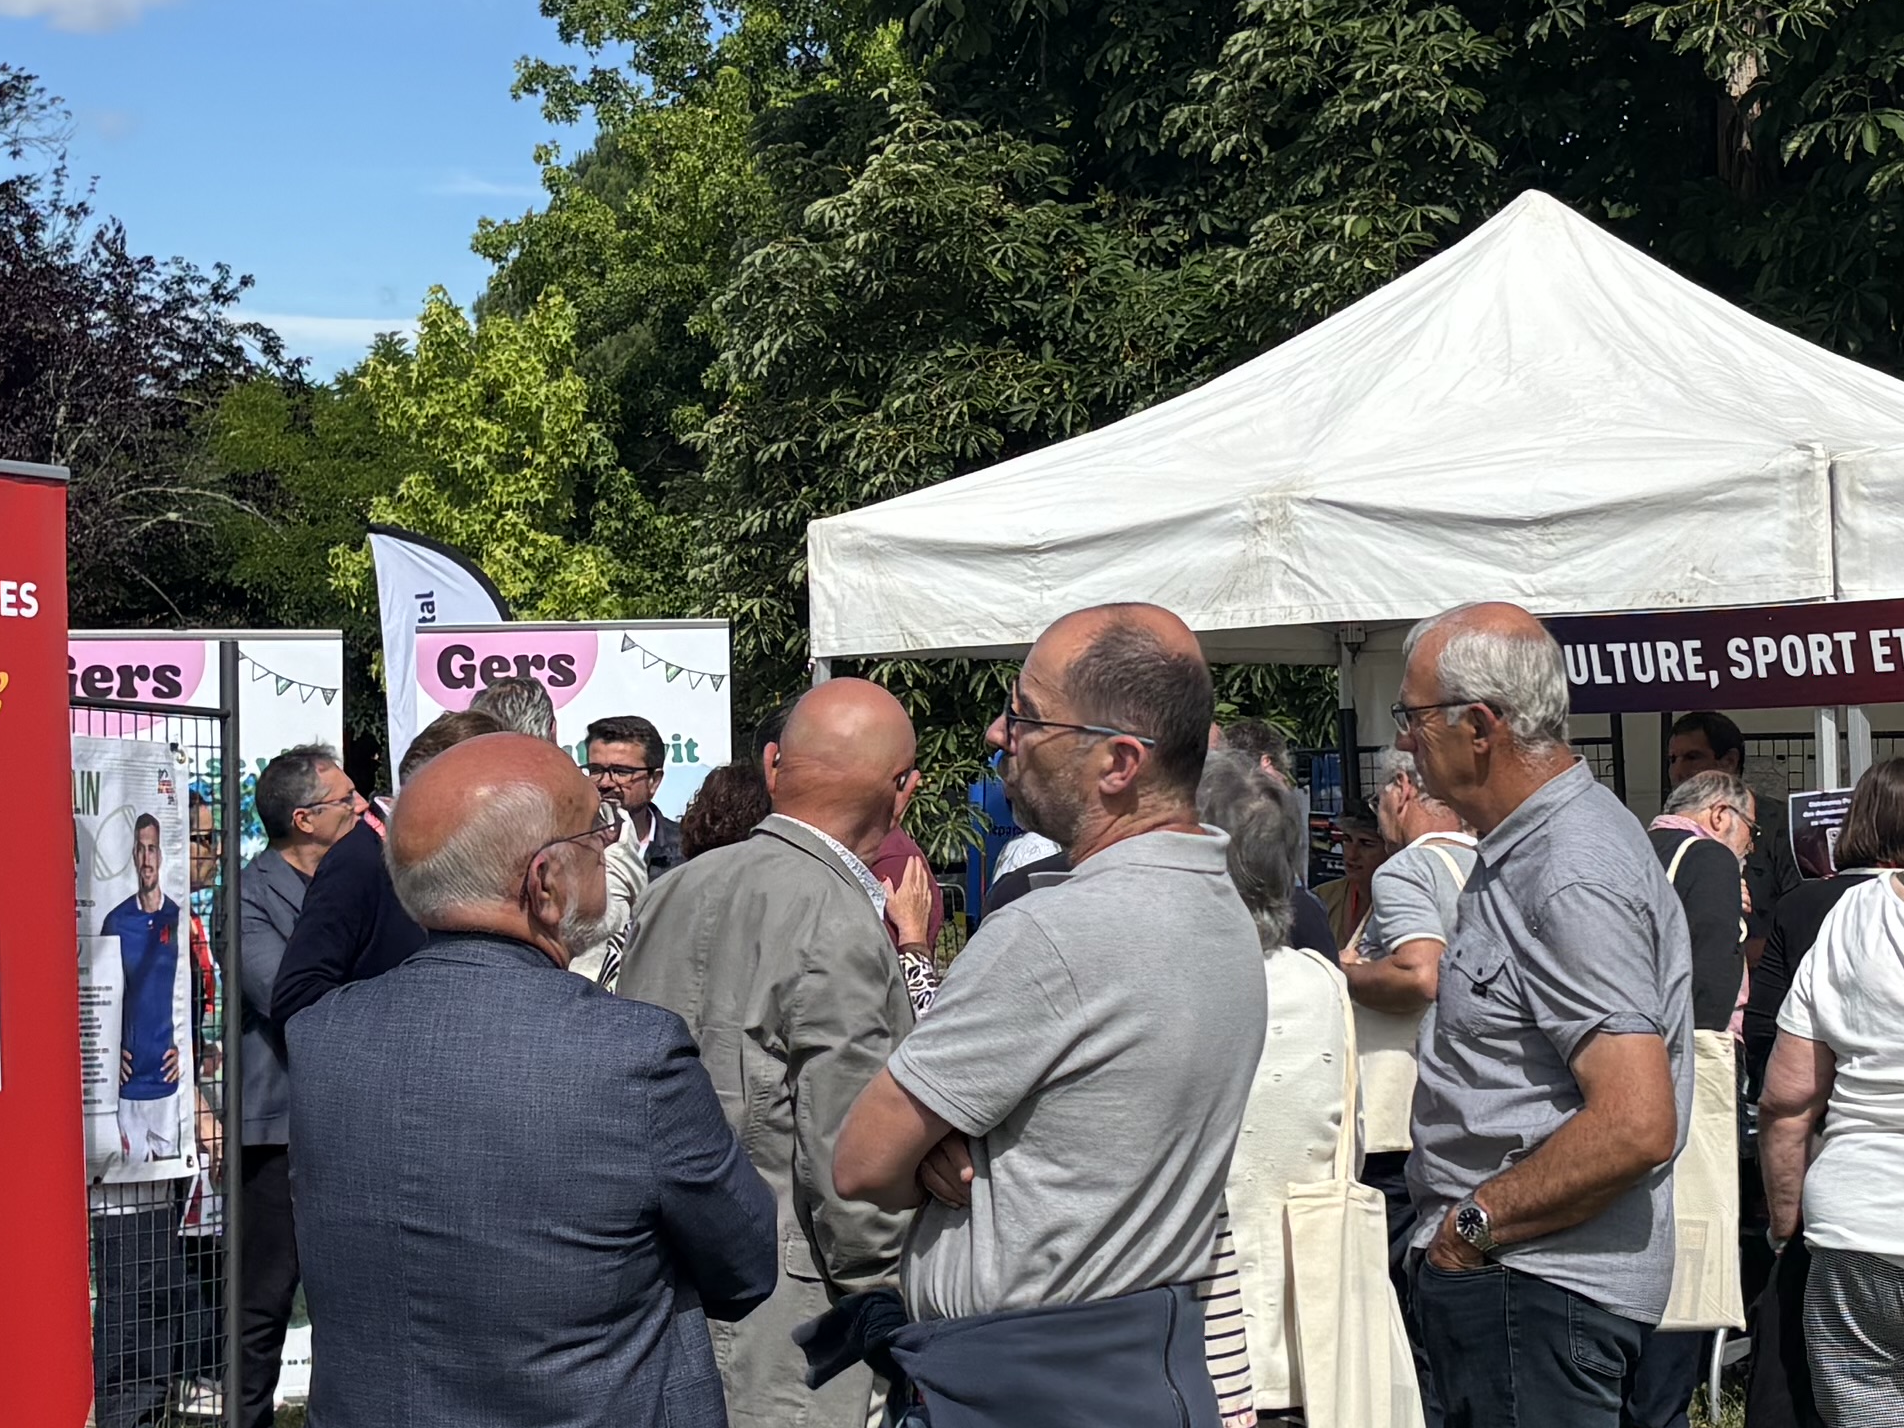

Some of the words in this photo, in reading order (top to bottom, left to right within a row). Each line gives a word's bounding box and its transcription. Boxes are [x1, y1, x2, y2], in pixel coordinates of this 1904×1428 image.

[415, 590, 436, 623] tal
[436, 644, 577, 690] Gers
[1563, 640, 1720, 689] ULTURE,
[1727, 630, 1859, 679] SPORT
